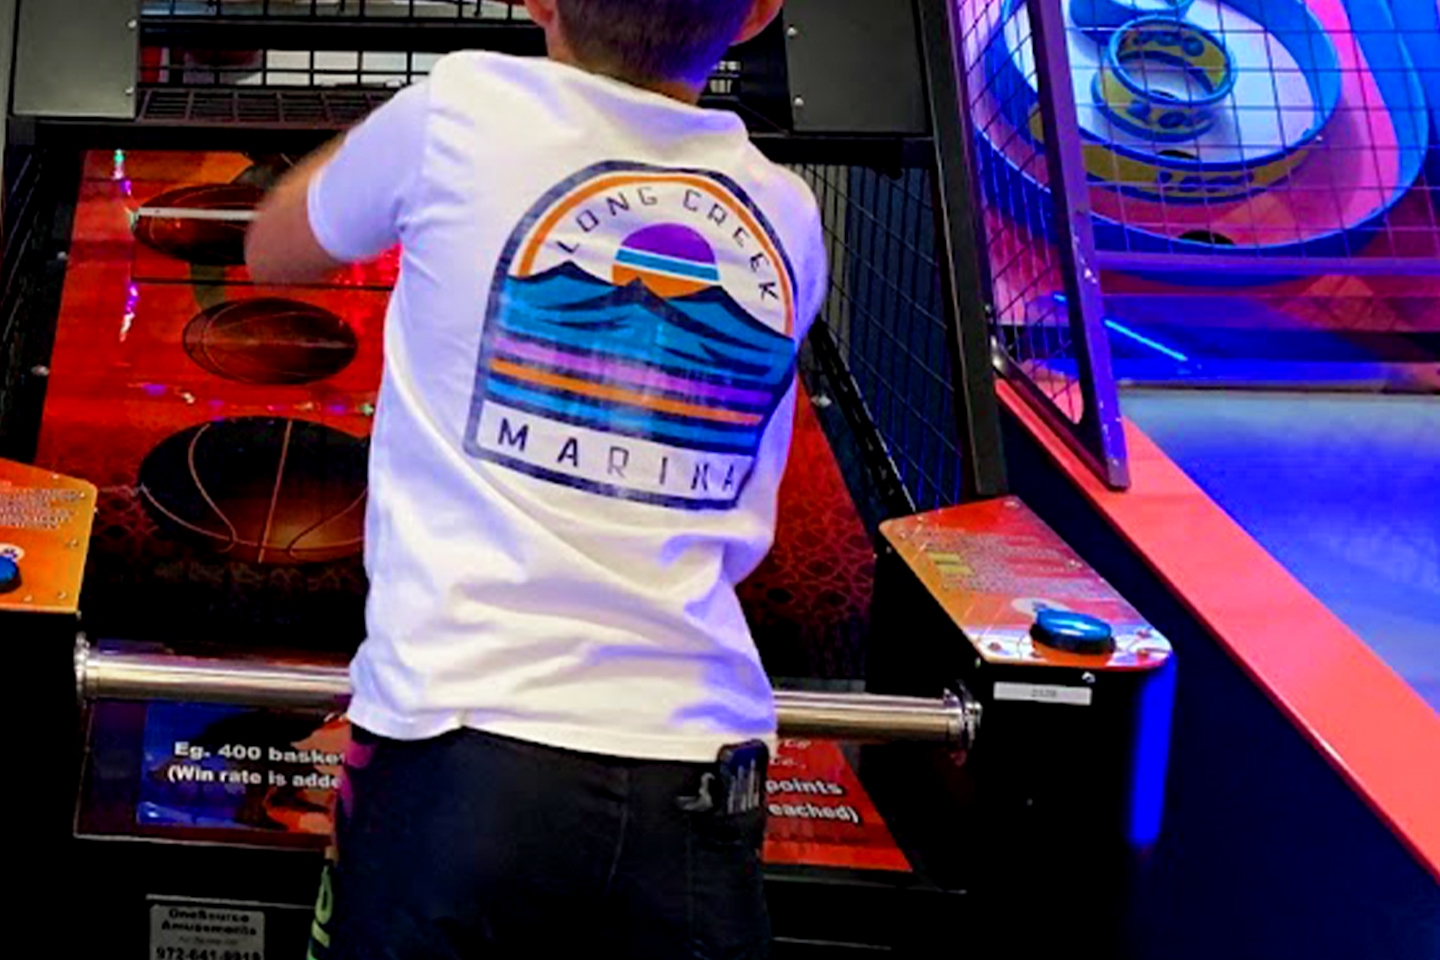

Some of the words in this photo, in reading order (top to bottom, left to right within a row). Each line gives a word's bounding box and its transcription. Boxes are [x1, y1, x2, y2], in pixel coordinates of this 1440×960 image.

[557, 186, 659, 254] LONG
[682, 189, 780, 302] CREEK
[497, 417, 735, 491] MARINA
[173, 740, 211, 759] Eg.
[217, 743, 262, 761] 400
[167, 763, 215, 784] (Win
[219, 766, 264, 785] rate
[268, 770, 287, 786] is
[291, 771, 342, 789] adde
[765, 778, 843, 795] points
[768, 803, 859, 824] eached)
